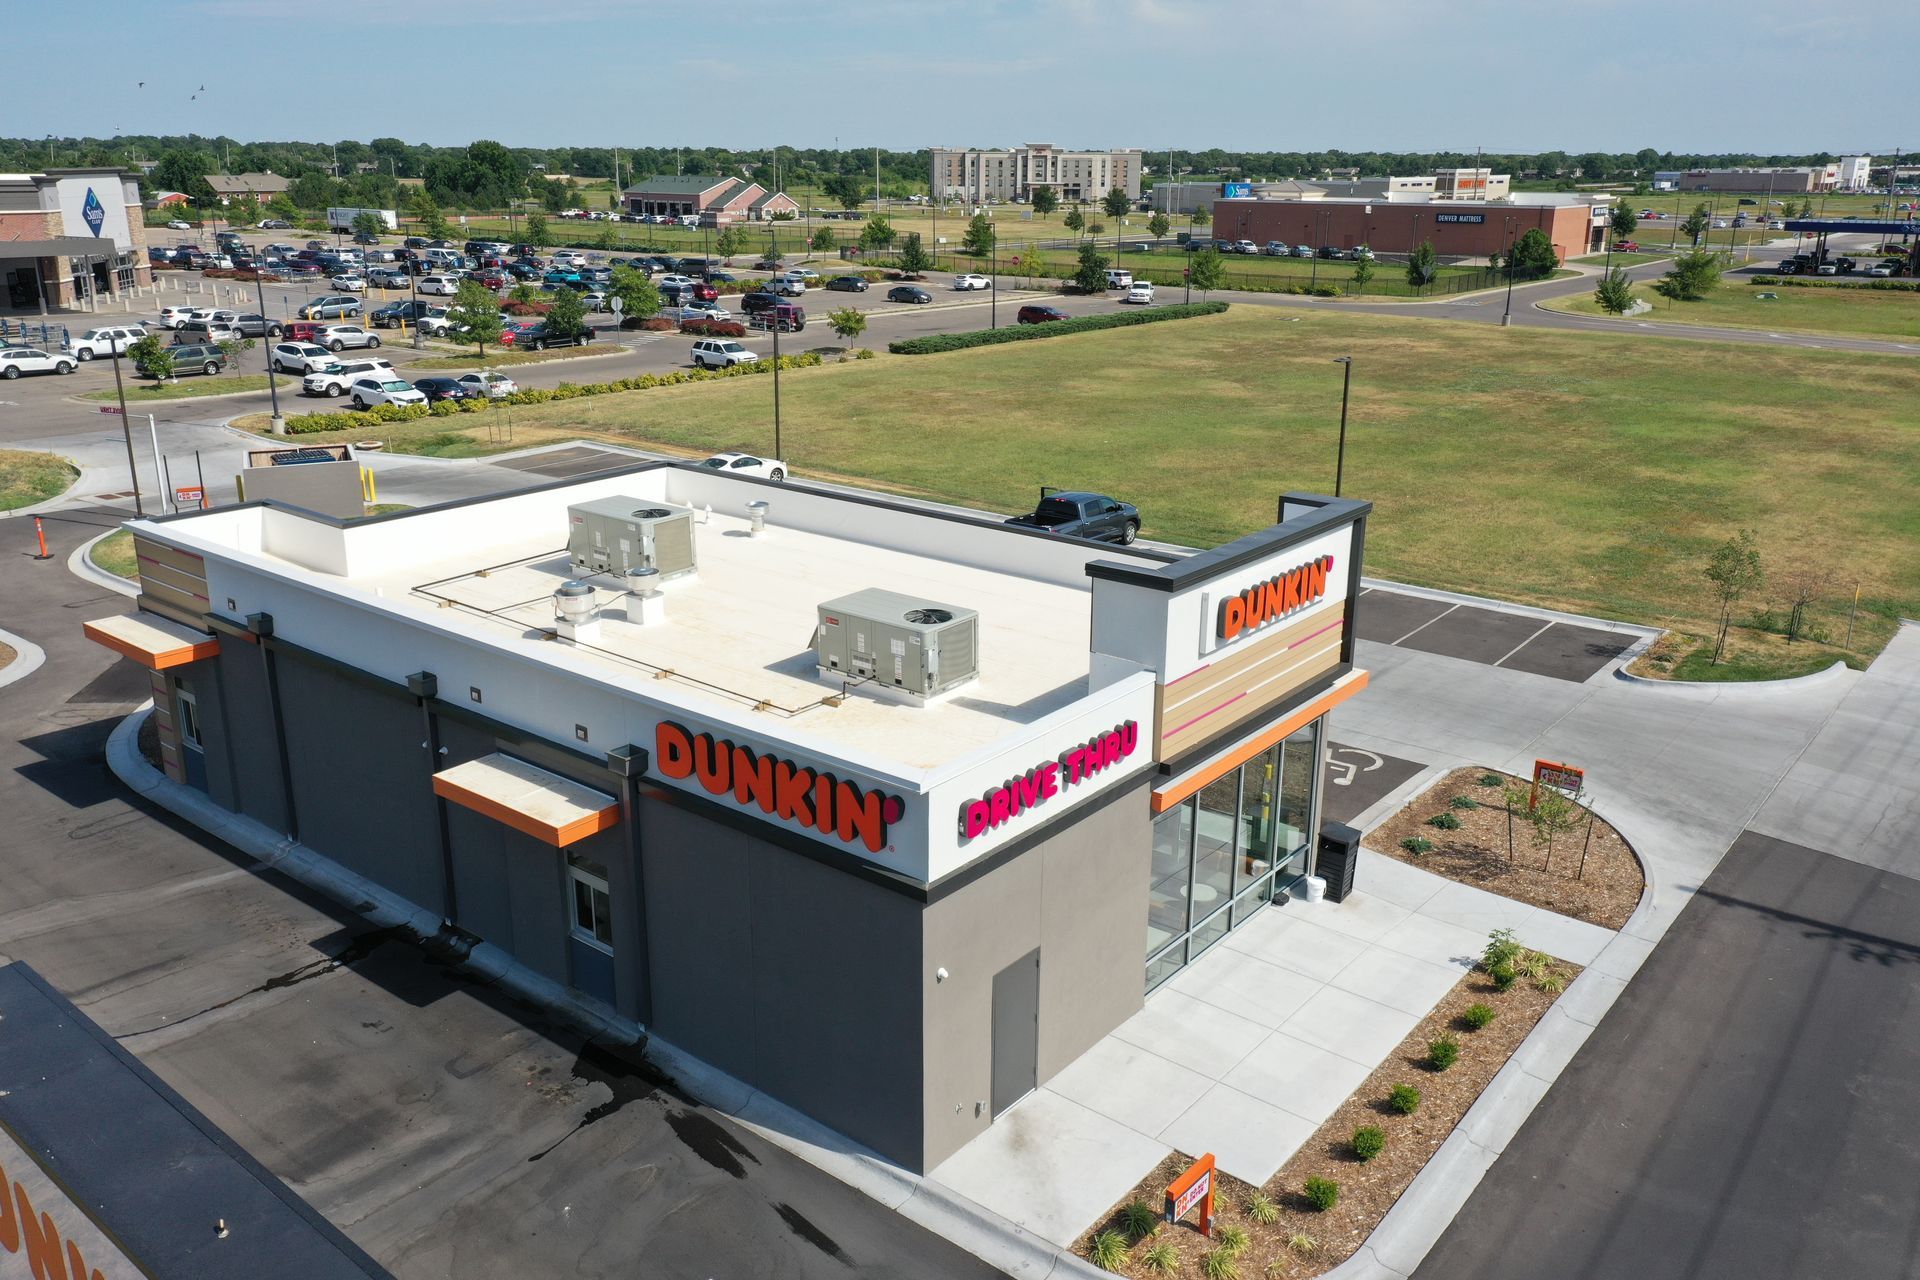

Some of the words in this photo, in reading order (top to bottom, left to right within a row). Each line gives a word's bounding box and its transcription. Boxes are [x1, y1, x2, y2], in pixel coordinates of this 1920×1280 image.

[1459, 215, 1482, 223] MATTRESS
[1217, 554, 1334, 641] DUNKIN'
[656, 720, 905, 853] DUNKIN'
[957, 760, 1059, 839] DRIVE
[1058, 719, 1138, 785] THRU
